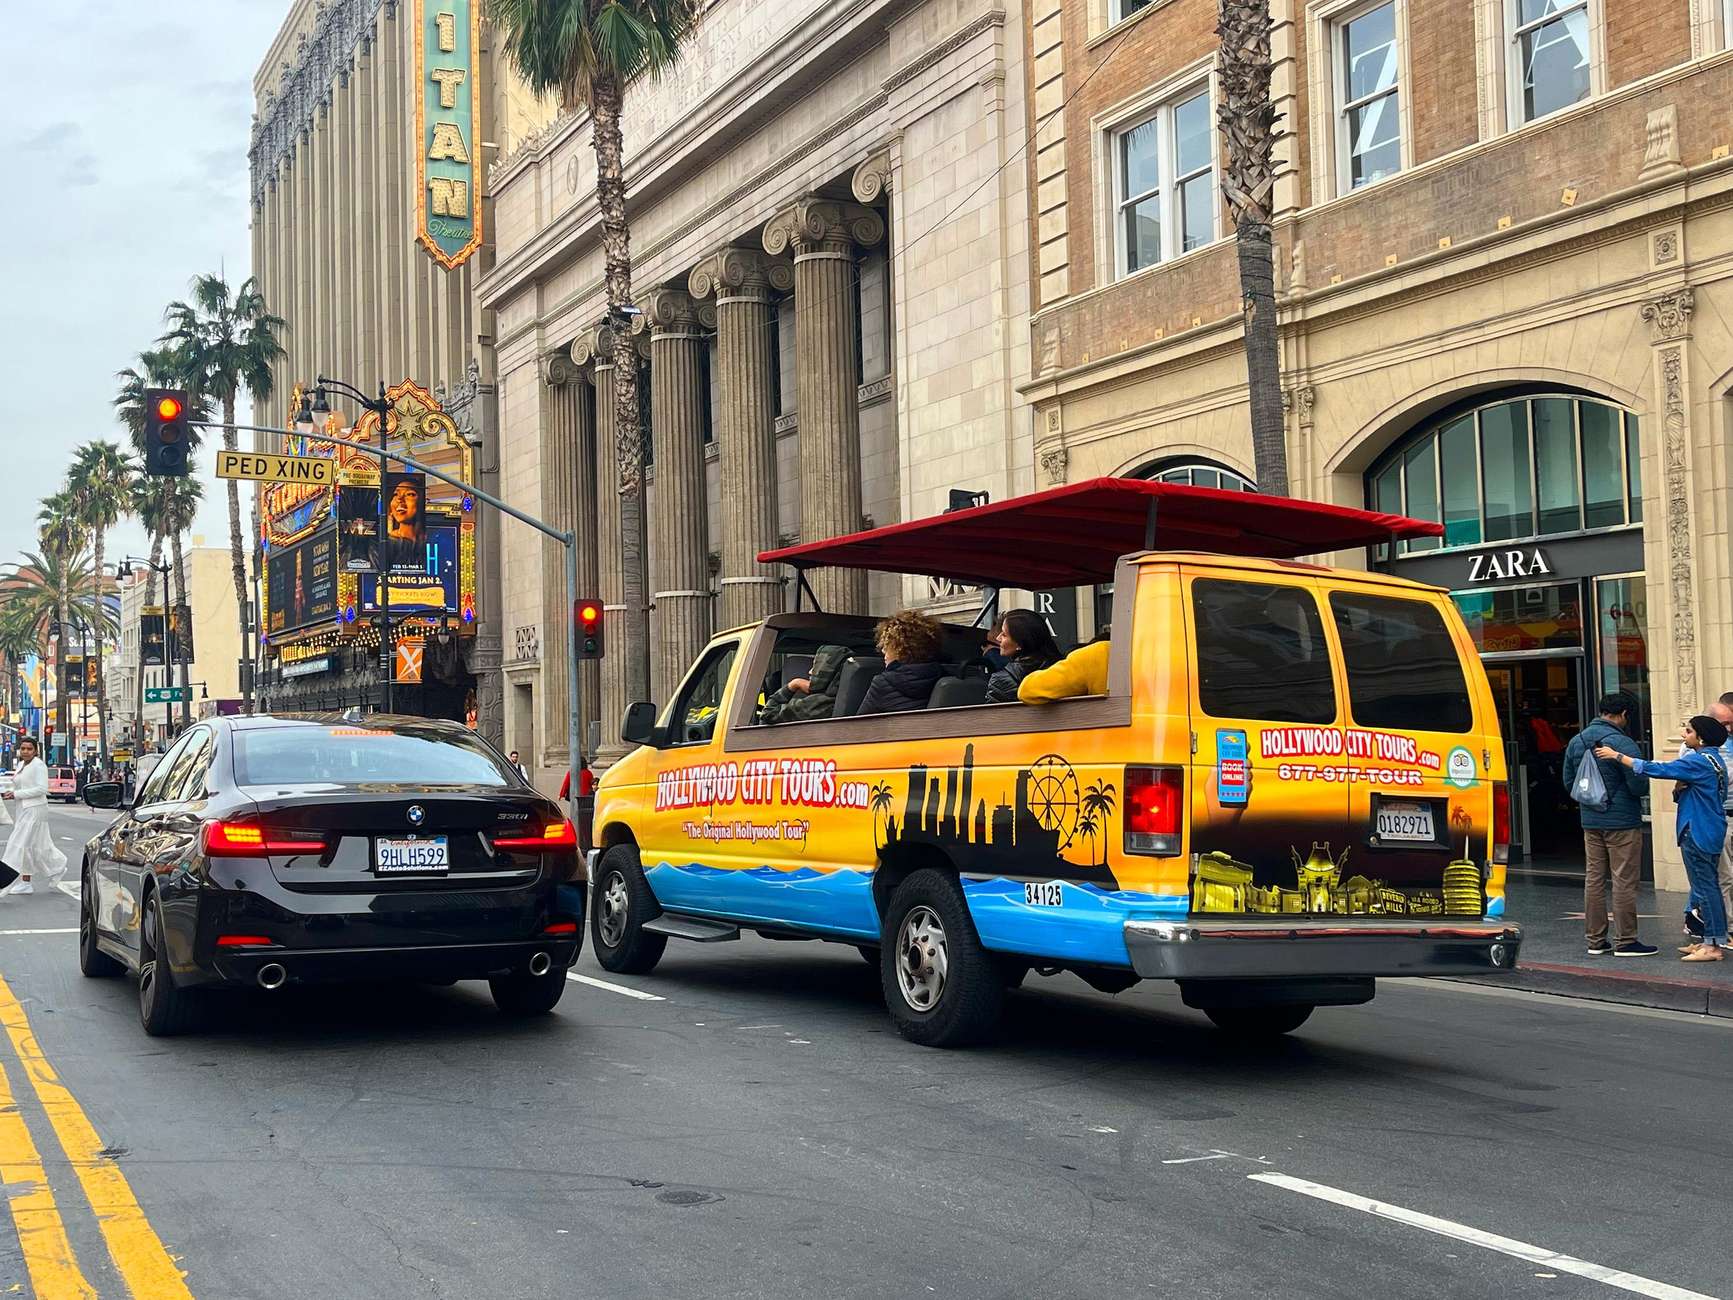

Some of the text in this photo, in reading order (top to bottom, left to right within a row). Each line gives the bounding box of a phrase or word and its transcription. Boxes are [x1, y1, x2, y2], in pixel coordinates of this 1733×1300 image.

[225, 456, 326, 480] PED XING
[1468, 548, 1550, 582] ZARA
[377, 576, 417, 585] SARTING
[418, 576, 434, 585] JAN
[1261, 729, 1342, 756] HOLLYWOOD
[1346, 731, 1372, 757] CITY
[1222, 763, 1244, 772] BOOK
[1222, 773, 1244, 781] ONLINE
[655, 763, 739, 809] HOLLYWOOD
[741, 760, 776, 804] CITY
[703, 822, 733, 843] Original
[735, 822, 780, 843] Hollywood
[380, 848, 444, 866] 9HLH599
[1026, 884, 1062, 906] 34125
